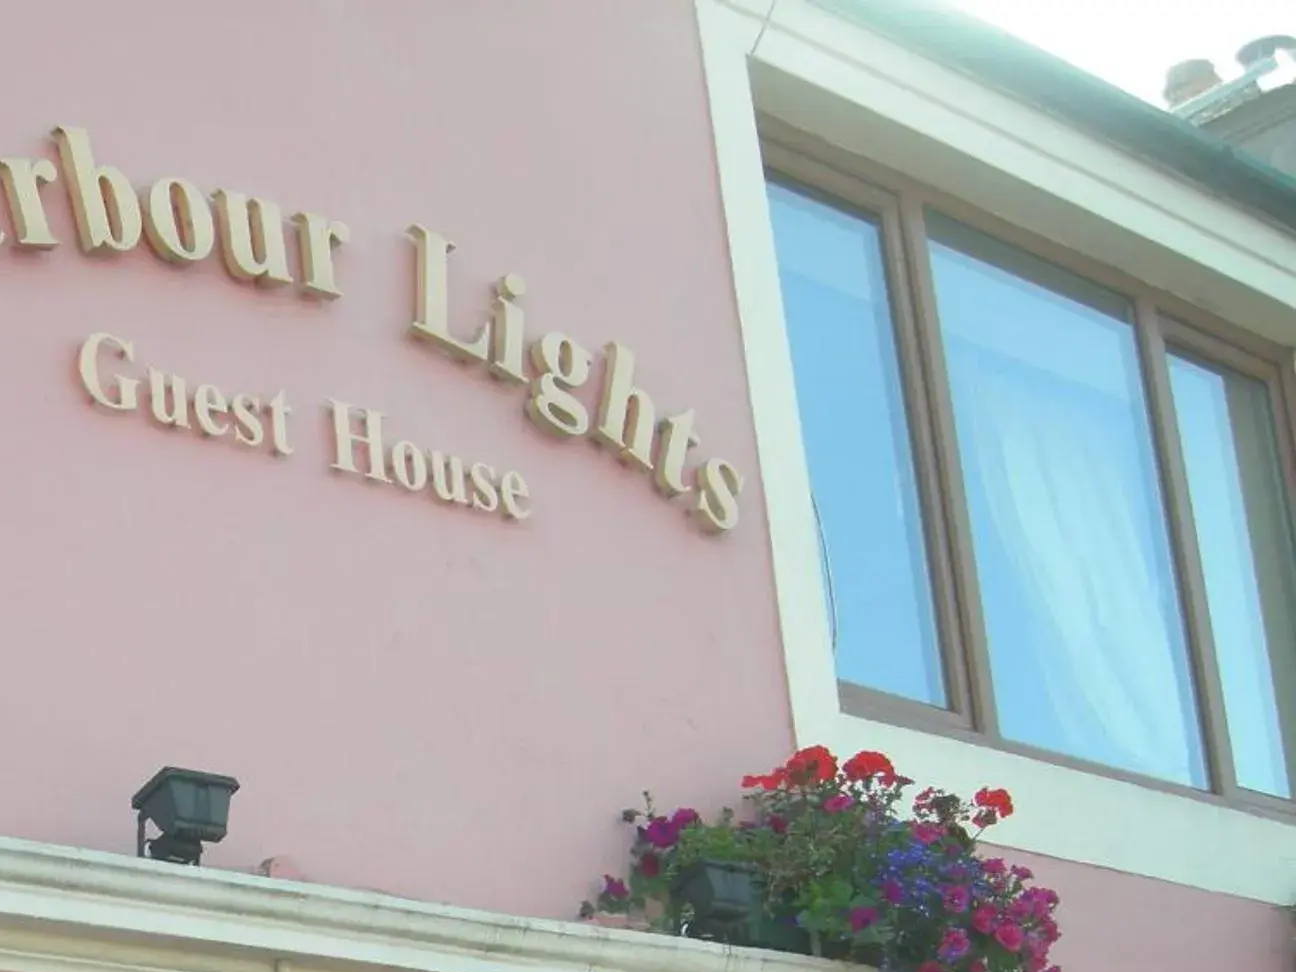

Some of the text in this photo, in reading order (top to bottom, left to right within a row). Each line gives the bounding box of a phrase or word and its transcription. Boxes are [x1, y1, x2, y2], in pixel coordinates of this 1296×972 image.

[75, 331, 532, 521] Guest House
[404, 222, 744, 534] Lights
